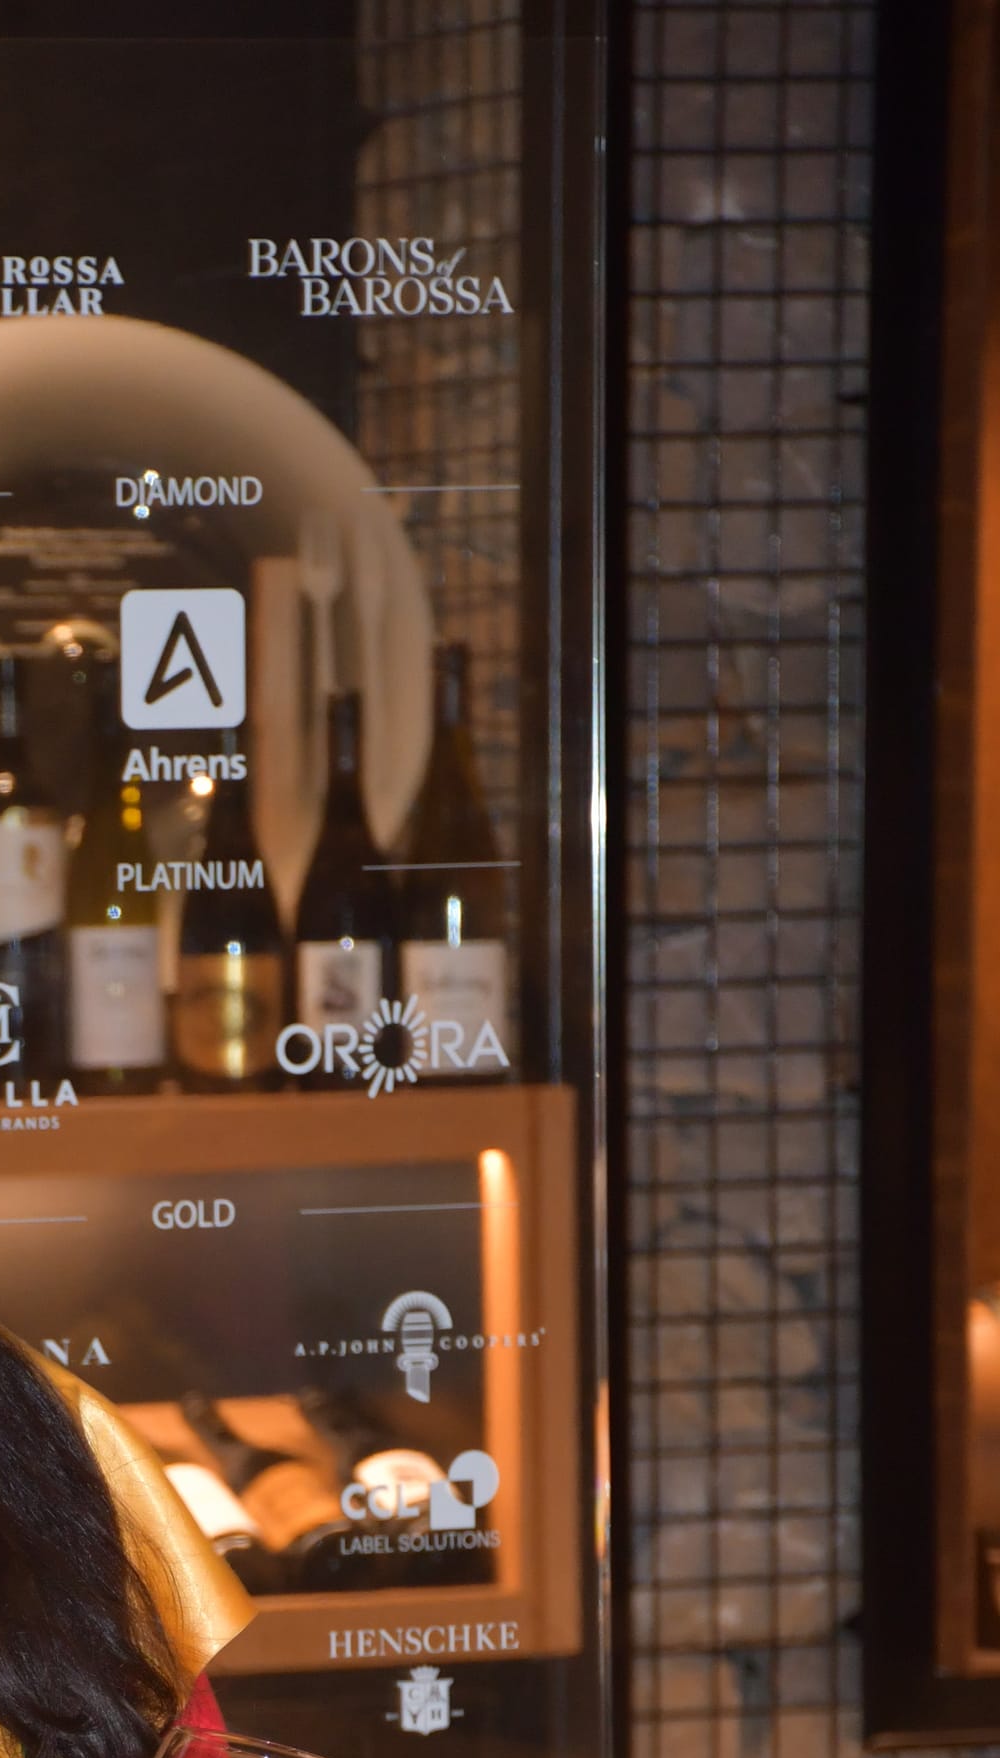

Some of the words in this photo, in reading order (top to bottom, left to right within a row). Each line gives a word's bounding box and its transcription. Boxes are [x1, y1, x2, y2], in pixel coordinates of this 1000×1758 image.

[248, 237, 435, 277] BARONS
[436, 247, 467, 280] of
[301, 276, 515, 316] BAROSSA
[115, 476, 263, 507] DIAMOND
[121, 746, 248, 782] Ahrens
[116, 860, 264, 892] PLATINUM
[152, 1199, 236, 1230] GOLD
[340, 1482, 421, 1520] CCL
[340, 1535, 394, 1555] LABEL
[398, 1530, 501, 1552] SOLUTIONS
[329, 1621, 520, 1659] HENSCHKE
